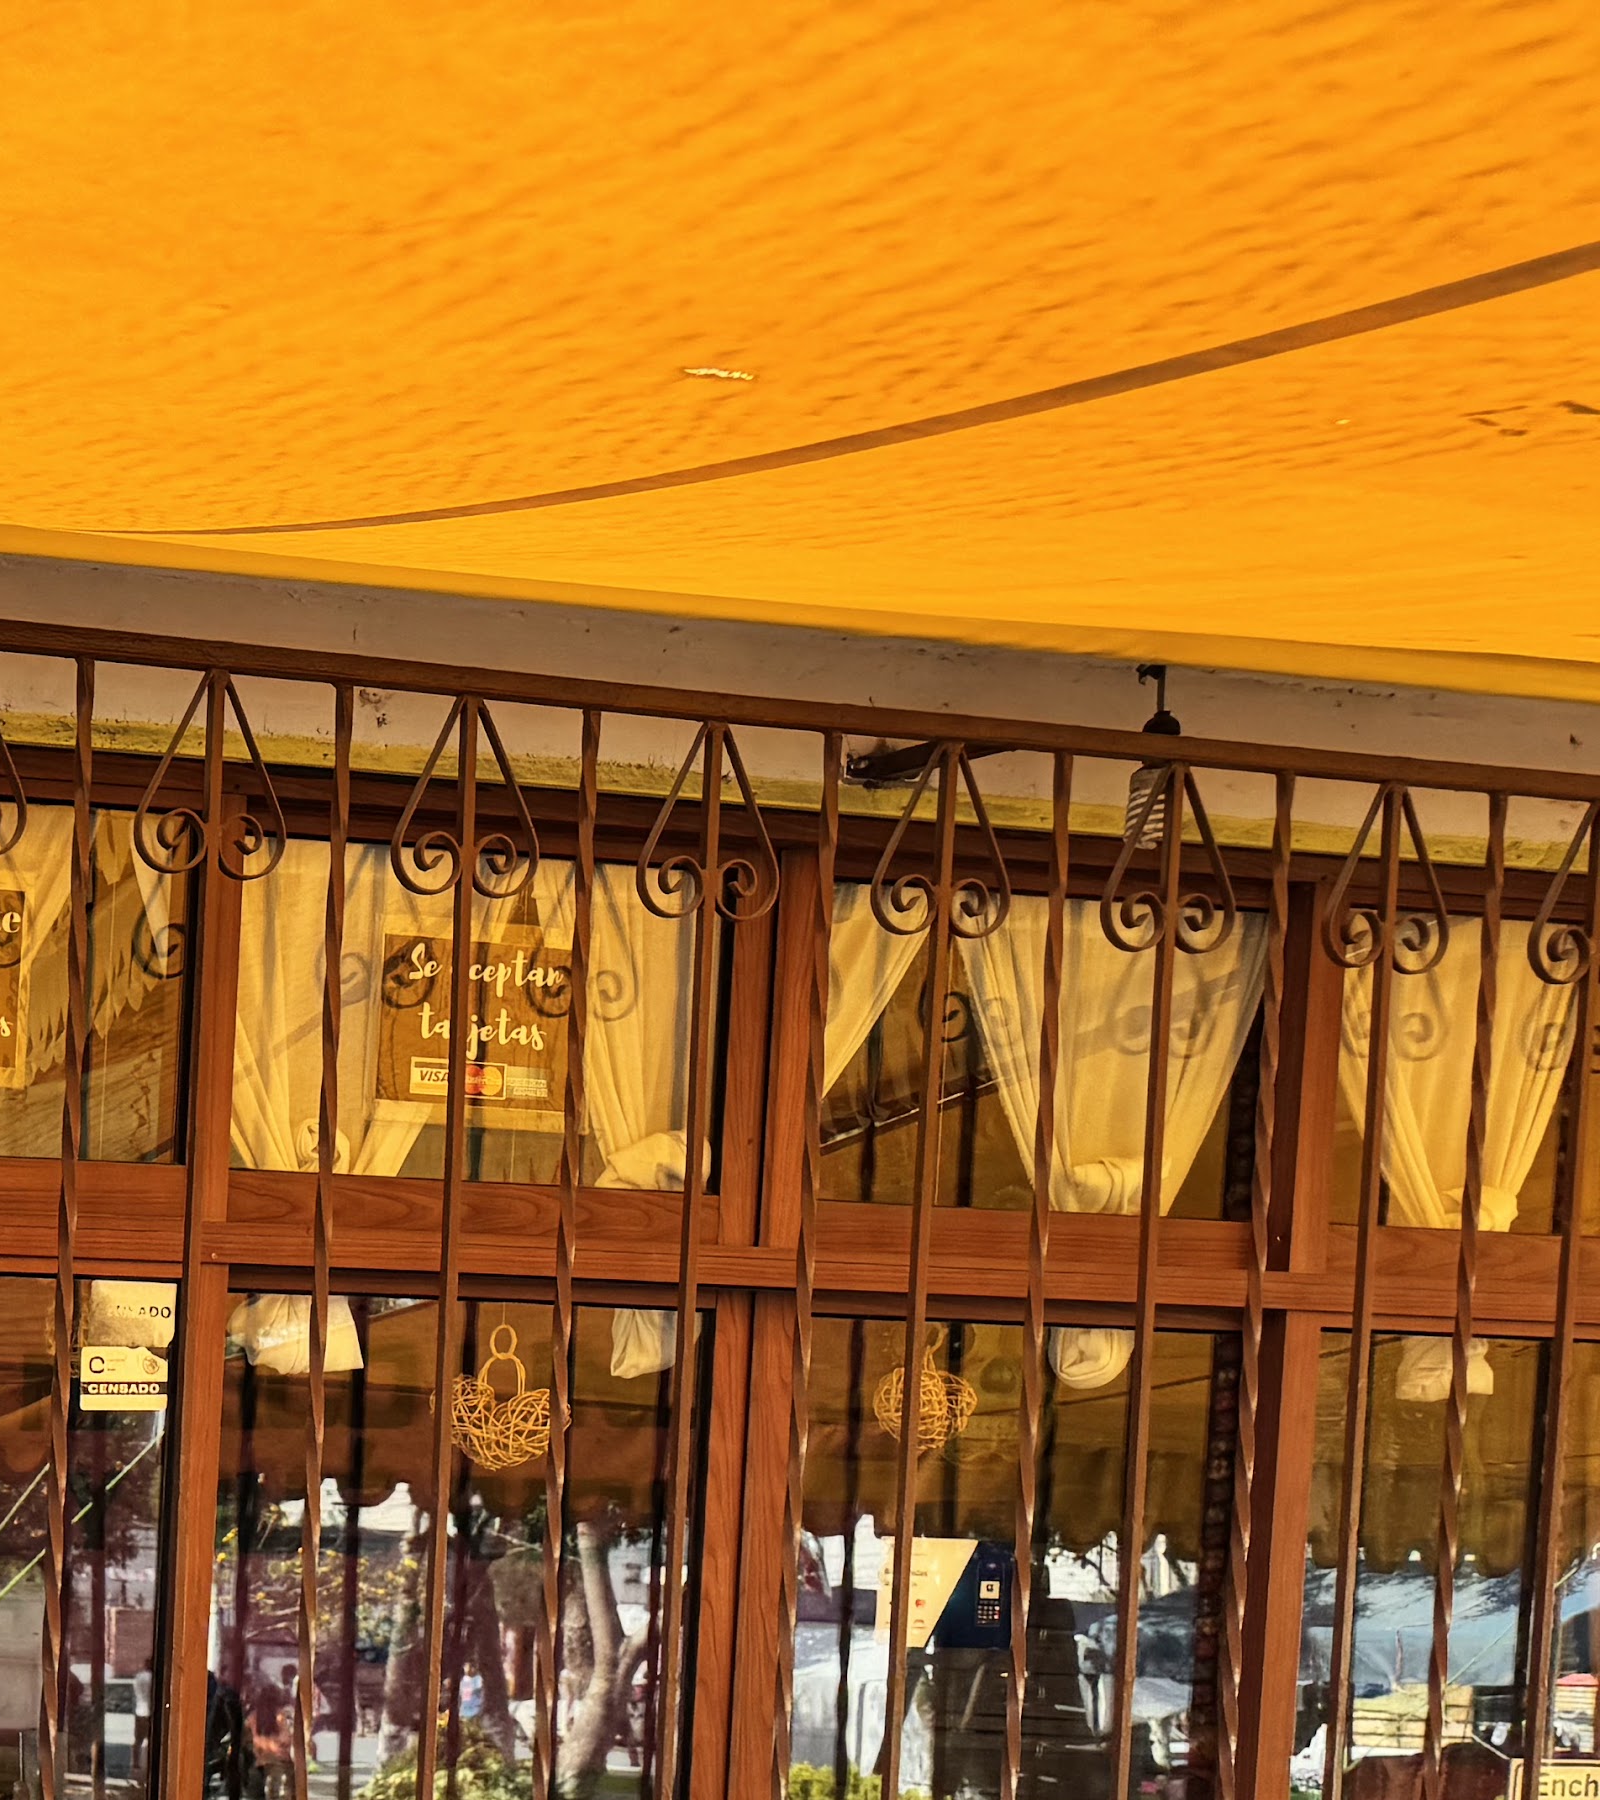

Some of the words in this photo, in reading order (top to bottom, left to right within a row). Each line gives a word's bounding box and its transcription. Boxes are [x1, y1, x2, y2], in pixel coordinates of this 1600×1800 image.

[408, 942, 443, 981] Se
[460, 950, 564, 998] ceptan
[417, 1001, 548, 1061] tajetas
[87, 1382, 161, 1394] CENSADO
